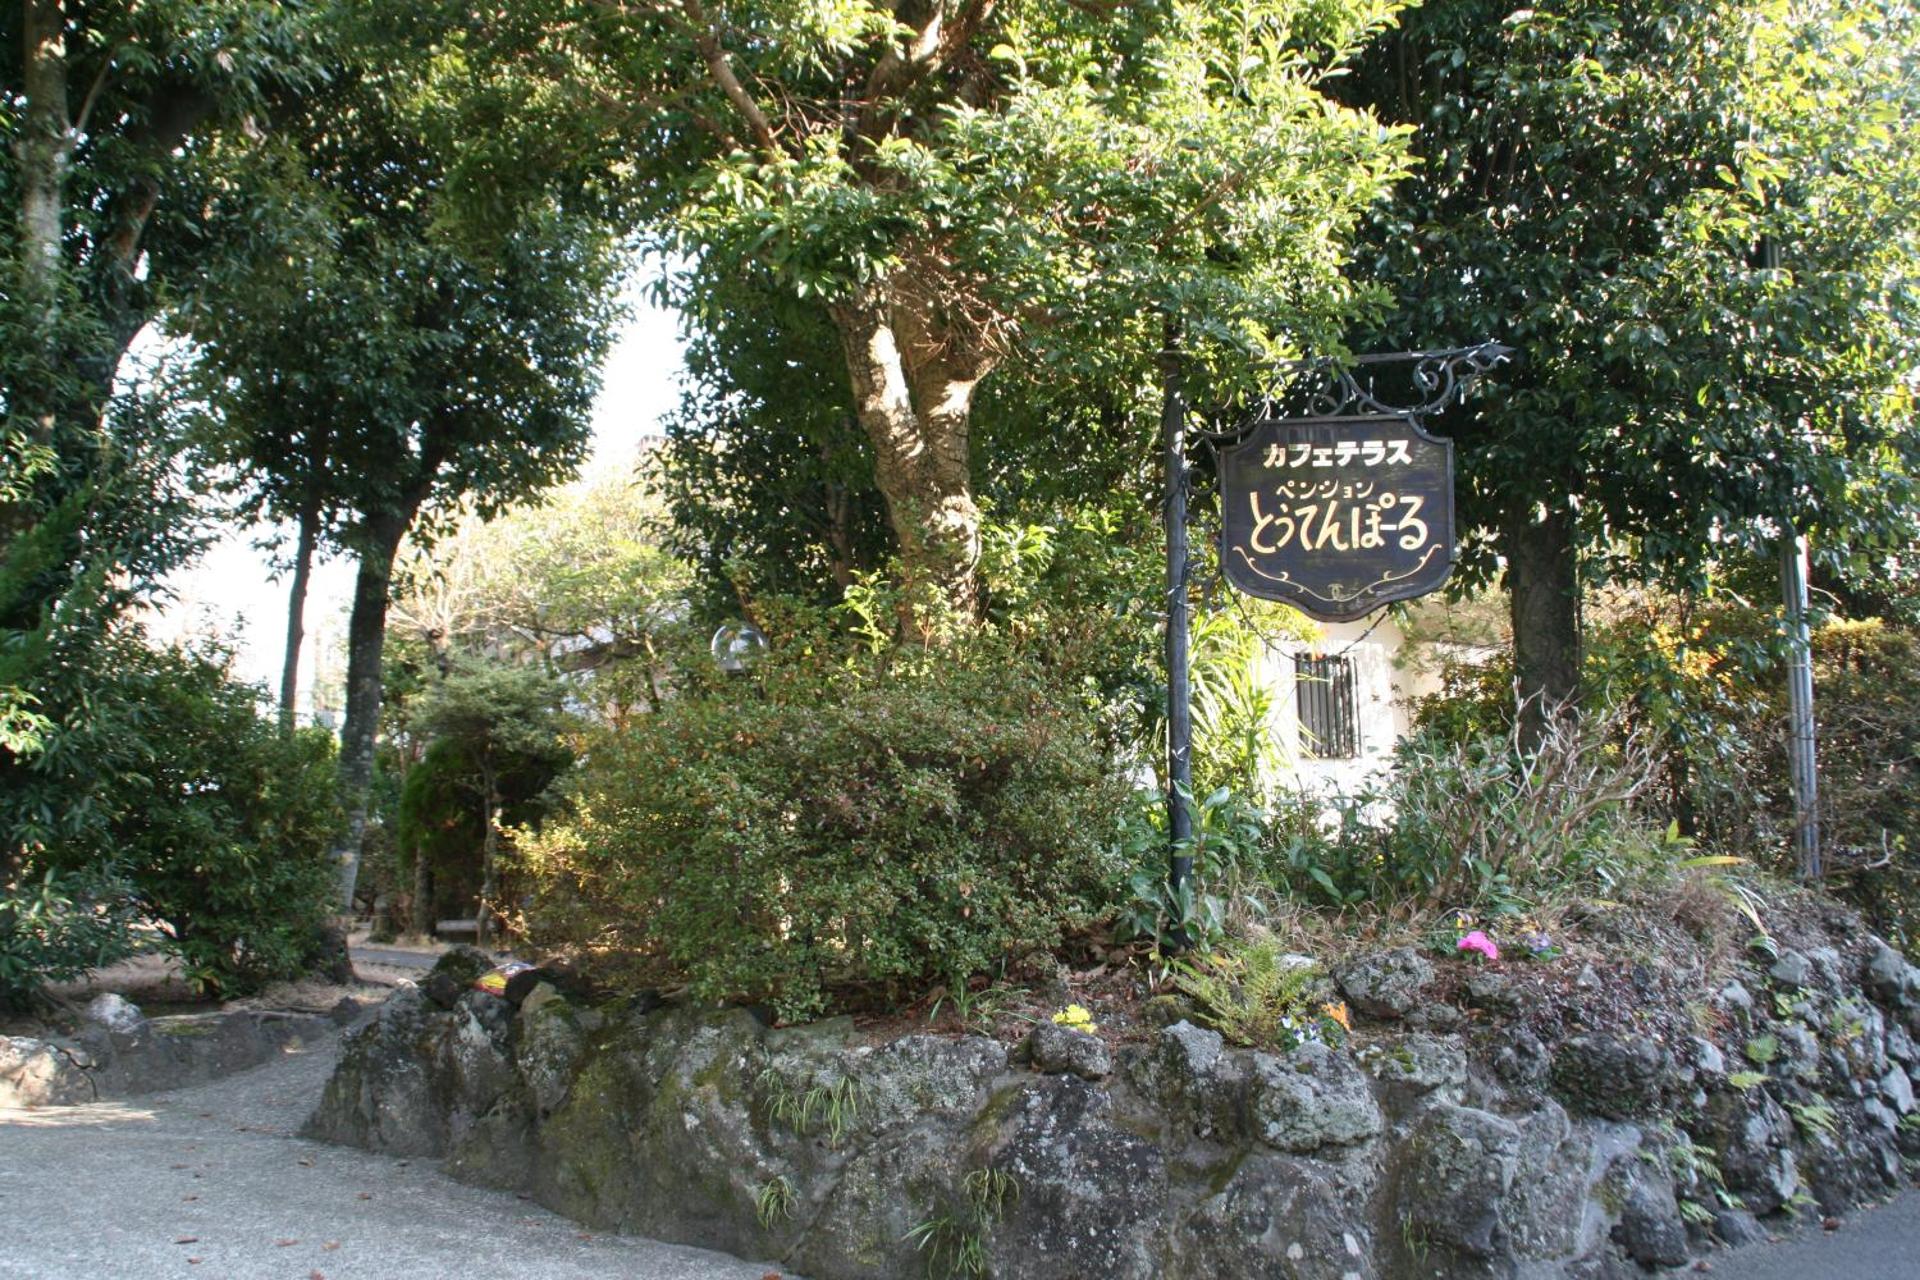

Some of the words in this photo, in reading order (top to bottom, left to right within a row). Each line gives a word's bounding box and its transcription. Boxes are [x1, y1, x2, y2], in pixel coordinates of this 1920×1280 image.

[1263, 440, 1412, 468] カフェテラス
[1276, 479, 1373, 499] ペンション
[1250, 491, 1428, 553] とうてんぽーる
